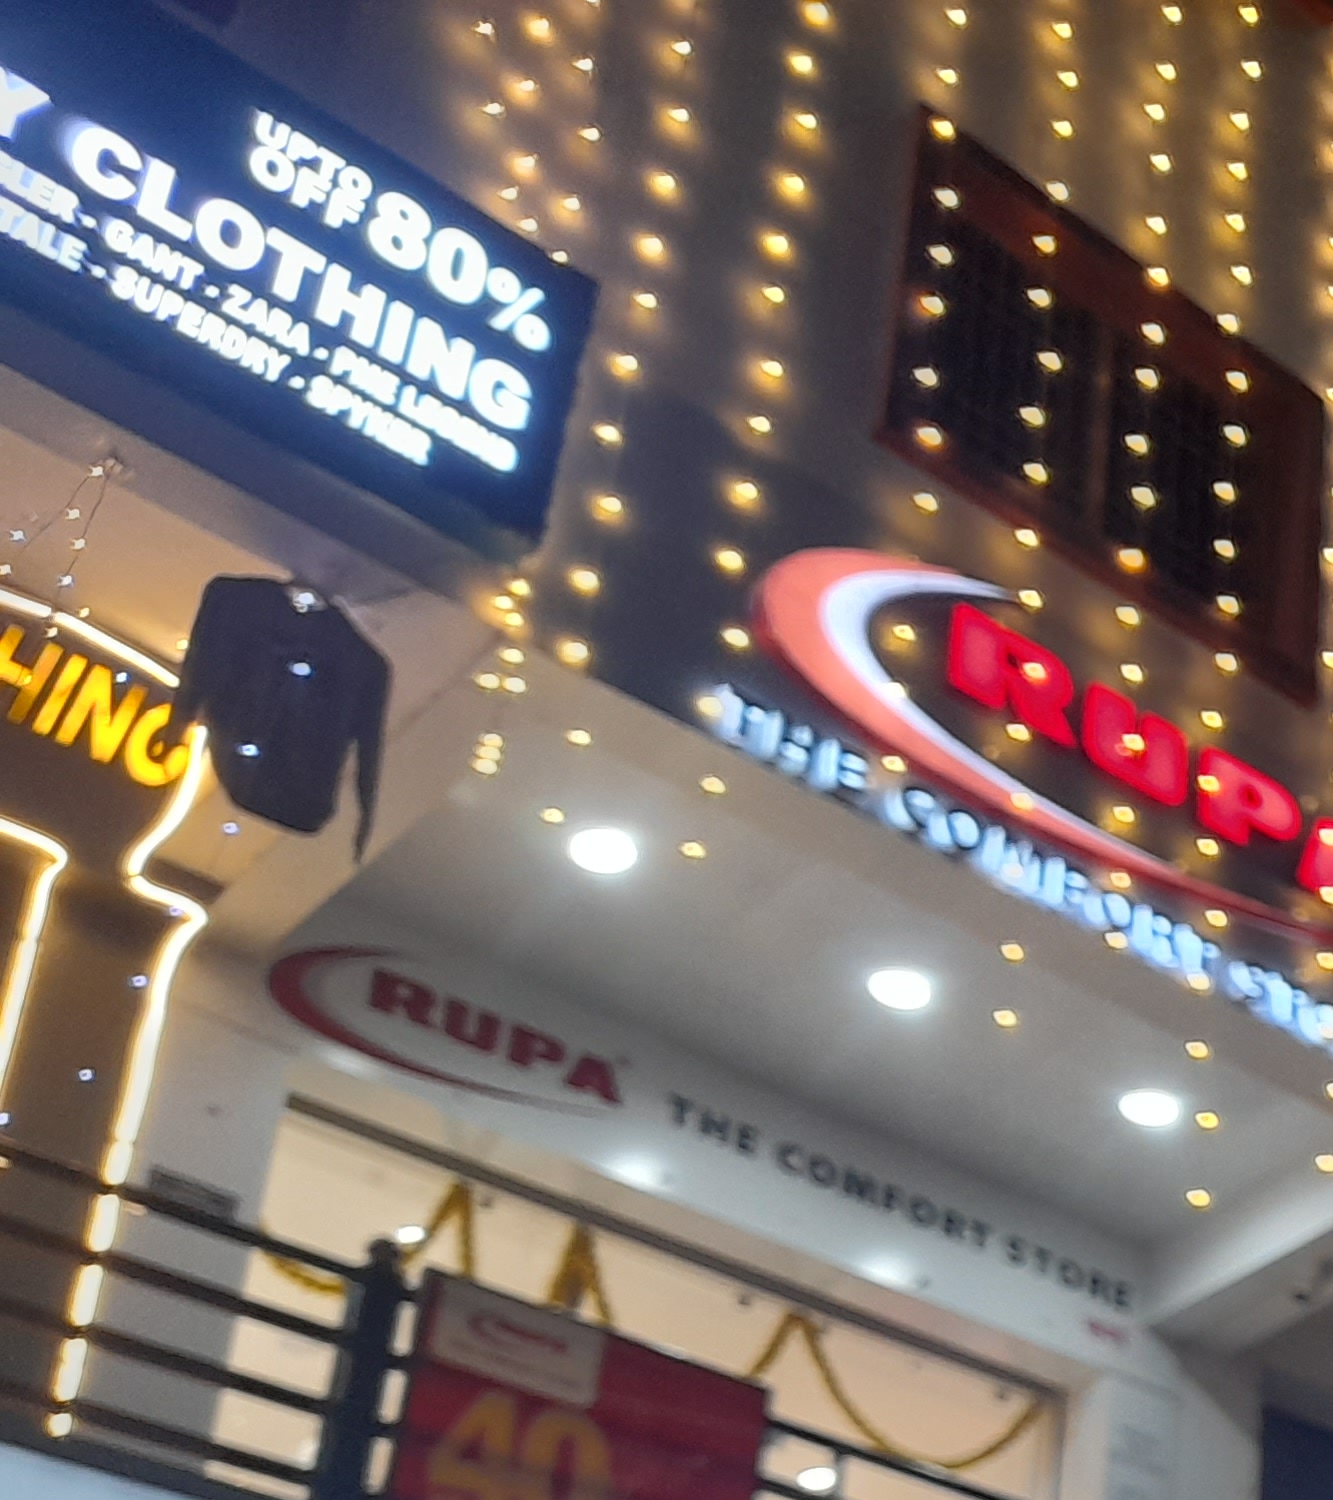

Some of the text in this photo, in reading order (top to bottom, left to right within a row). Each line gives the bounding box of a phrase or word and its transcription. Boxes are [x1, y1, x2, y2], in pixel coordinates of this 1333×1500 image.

[248, 145, 366, 230] OFF
[254, 110, 374, 202] UPTO
[66, 125, 534, 432] CLOTHING
[103, 218, 205, 291] GANT
[221, 282, 311, 358] ZARA
[109, 263, 292, 382] SUPERDRY
[367, 190, 551, 352] 80%
[698, 682, 869, 792] THE
[880, 782, 1222, 978] COMFORT
[367, 964, 624, 1106] RUPA
[668, 1093, 1135, 1309] THE COMFORT STORE
